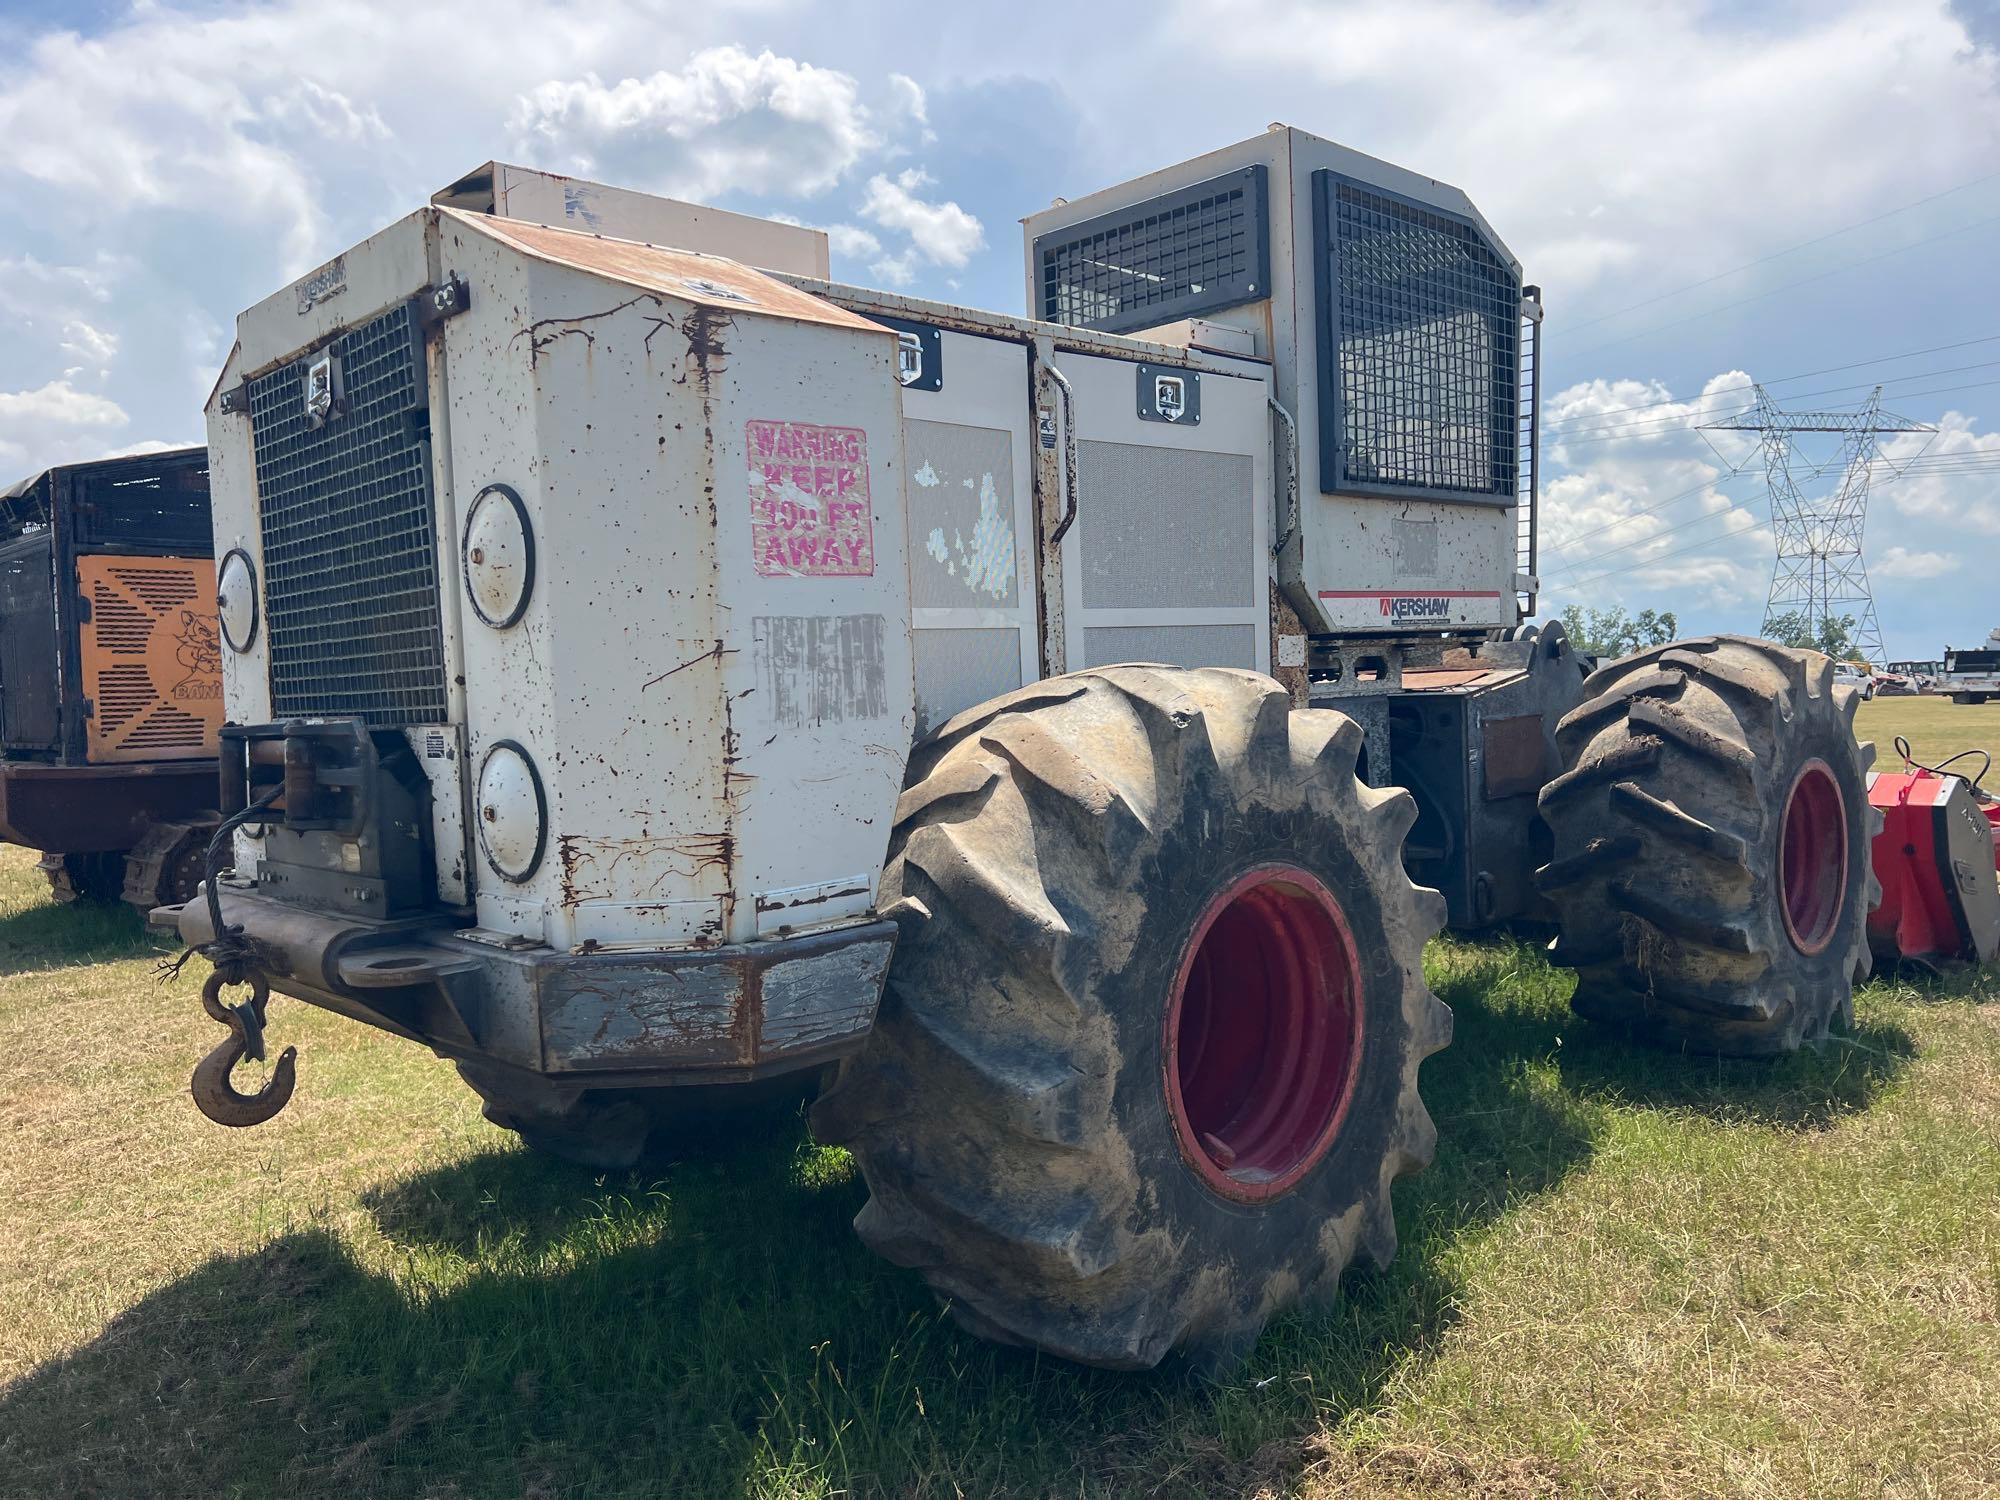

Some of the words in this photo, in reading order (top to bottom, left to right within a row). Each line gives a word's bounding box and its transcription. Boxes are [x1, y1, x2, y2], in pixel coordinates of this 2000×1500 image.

[755, 426, 859, 463] WARNING
[764, 463, 856, 497] KEEP
[828, 503, 863, 531] FT
[764, 536, 864, 567] AWAY
[1391, 597, 1450, 619] KERSHAW
